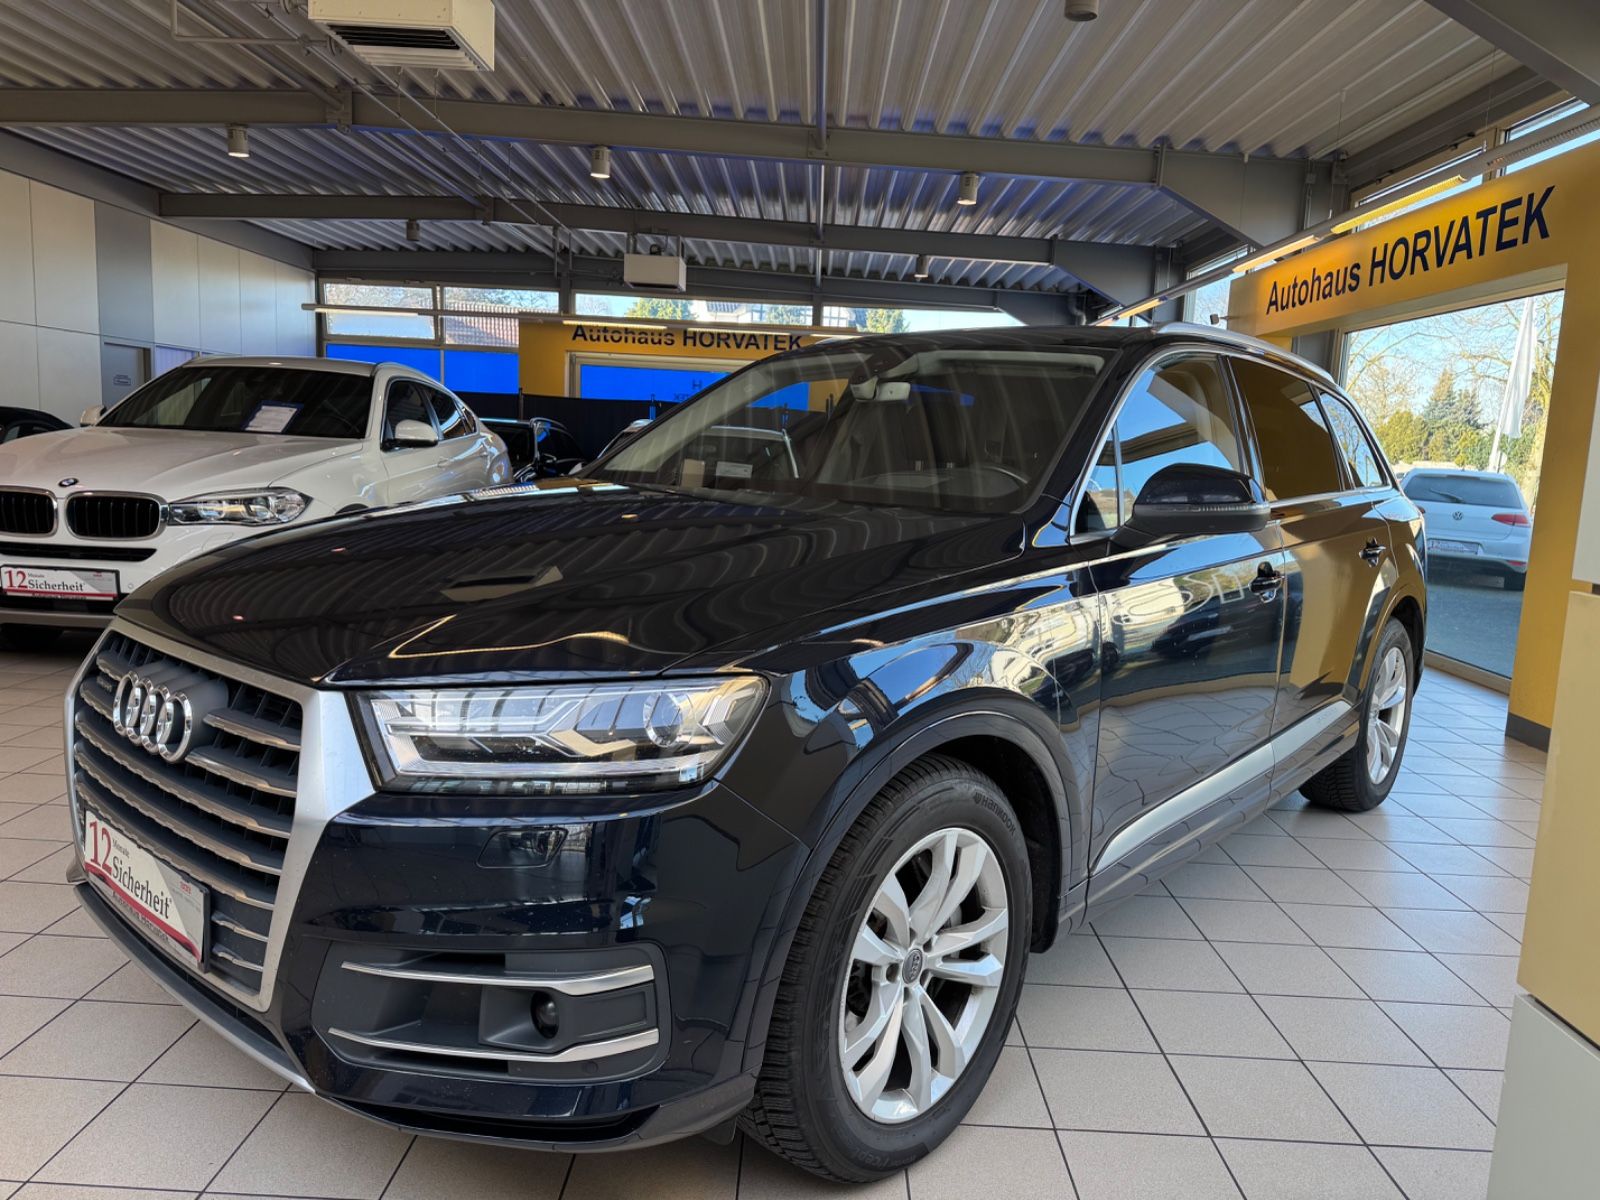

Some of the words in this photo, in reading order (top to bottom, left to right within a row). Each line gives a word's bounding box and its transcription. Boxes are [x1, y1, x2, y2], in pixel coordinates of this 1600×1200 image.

[1266, 262, 1361, 315] Autohaus
[1368, 185, 1556, 288] HORVATEK
[572, 325, 675, 346] Autohaus
[682, 330, 802, 351] HORVATEK
[4, 569, 28, 589] 12
[89, 820, 113, 875] 12
[112, 855, 169, 920] Sicherheit
